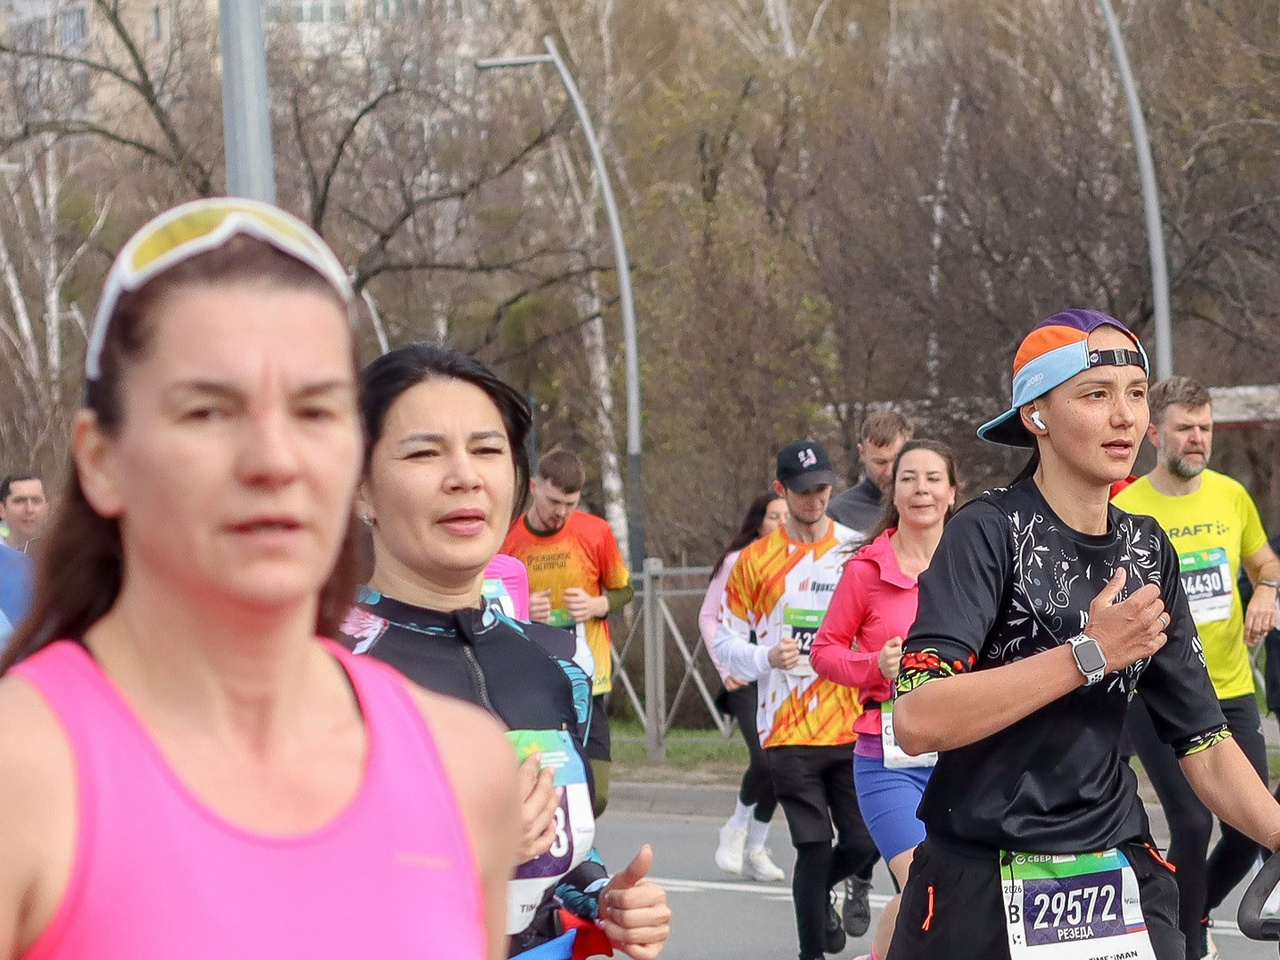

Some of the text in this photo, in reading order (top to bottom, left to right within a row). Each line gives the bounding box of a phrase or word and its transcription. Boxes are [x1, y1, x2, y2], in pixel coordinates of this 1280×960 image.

[1166, 523, 1214, 539] RAFT
[1184, 572, 1221, 595] 4430
[1027, 855, 1051, 863] СБЕР
[1033, 884, 1117, 930] 29572
[1057, 926, 1095, 941] РЕЗЕДА
